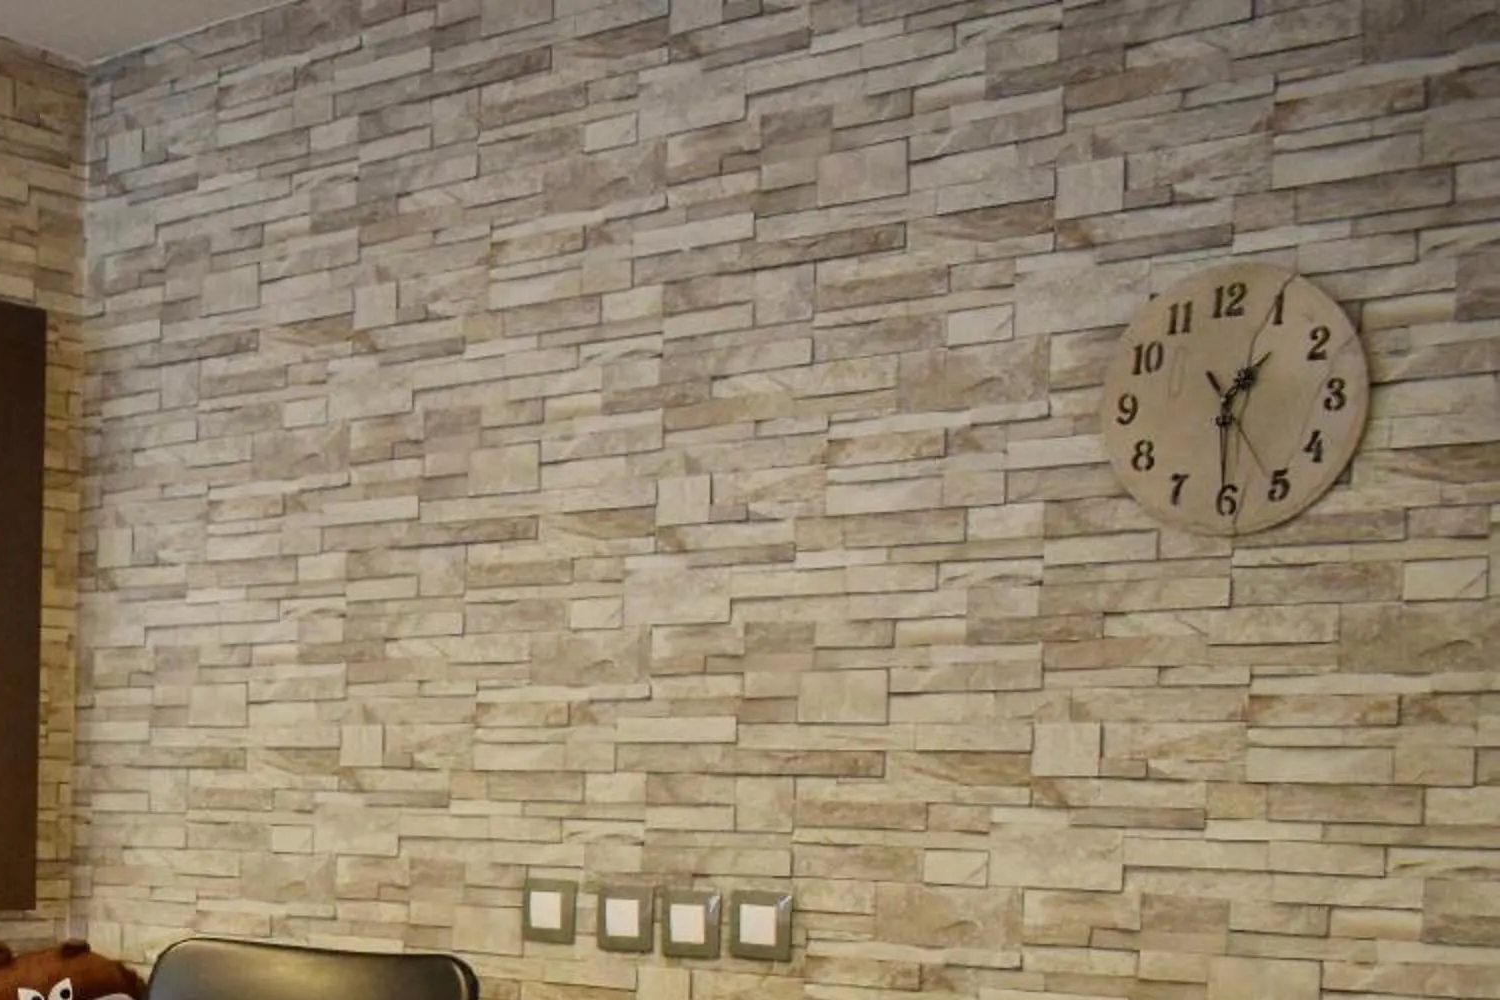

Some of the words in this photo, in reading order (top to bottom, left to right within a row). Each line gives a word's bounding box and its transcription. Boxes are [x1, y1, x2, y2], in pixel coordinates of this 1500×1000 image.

[1211, 282, 1247, 319] 12
[1273, 291, 1285, 325] 1
[1167, 300, 1193, 335] 11
[1132, 341, 1164, 375] 10
[1306, 326, 1331, 360] 2
[1116, 393, 1139, 425] 9
[1323, 377, 1347, 411] 3
[1130, 440, 1155, 471] 8
[1303, 430, 1324, 463] 4
[1170, 473, 1190, 505] 7
[1215, 484, 1238, 516] 6
[1267, 468, 1291, 501] 5
